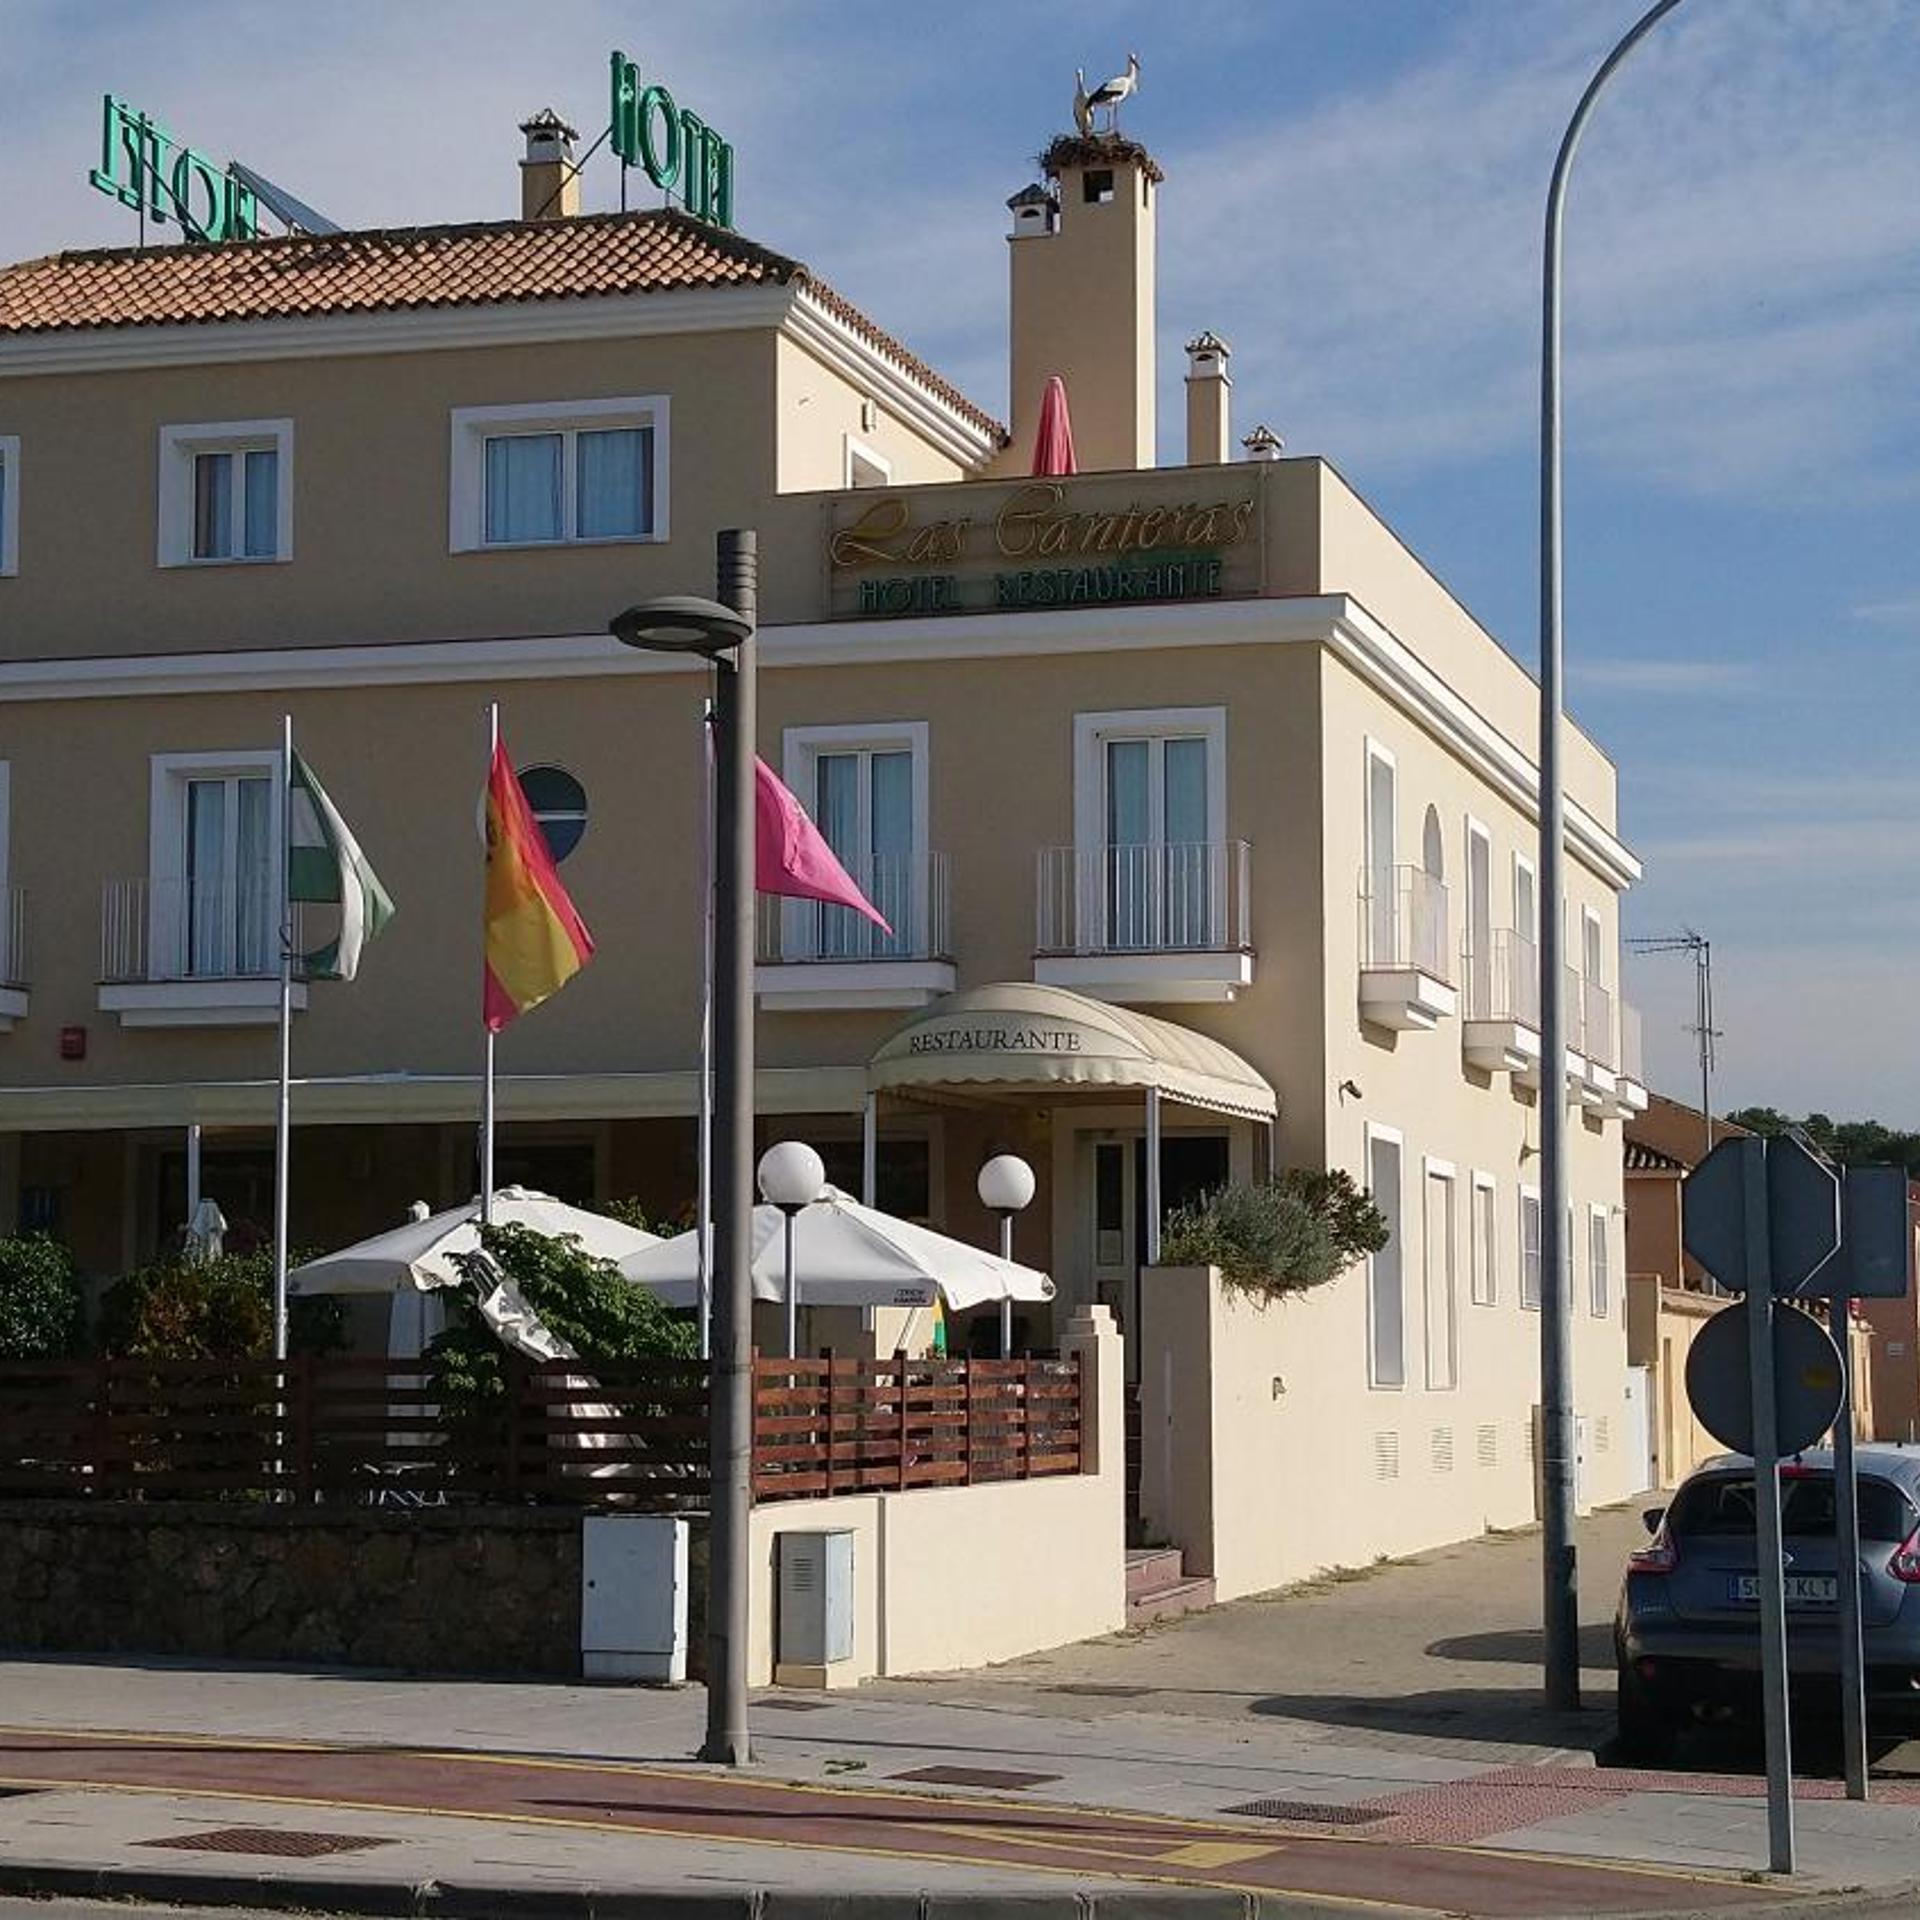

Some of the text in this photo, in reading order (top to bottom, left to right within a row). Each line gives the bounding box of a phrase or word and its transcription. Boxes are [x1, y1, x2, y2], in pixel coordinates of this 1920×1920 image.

[830, 483, 1254, 568] Las Canteras
[858, 560, 1223, 613] HOTEL RESTAURANTE
[909, 1029, 1082, 1054] RESTAURANTE
